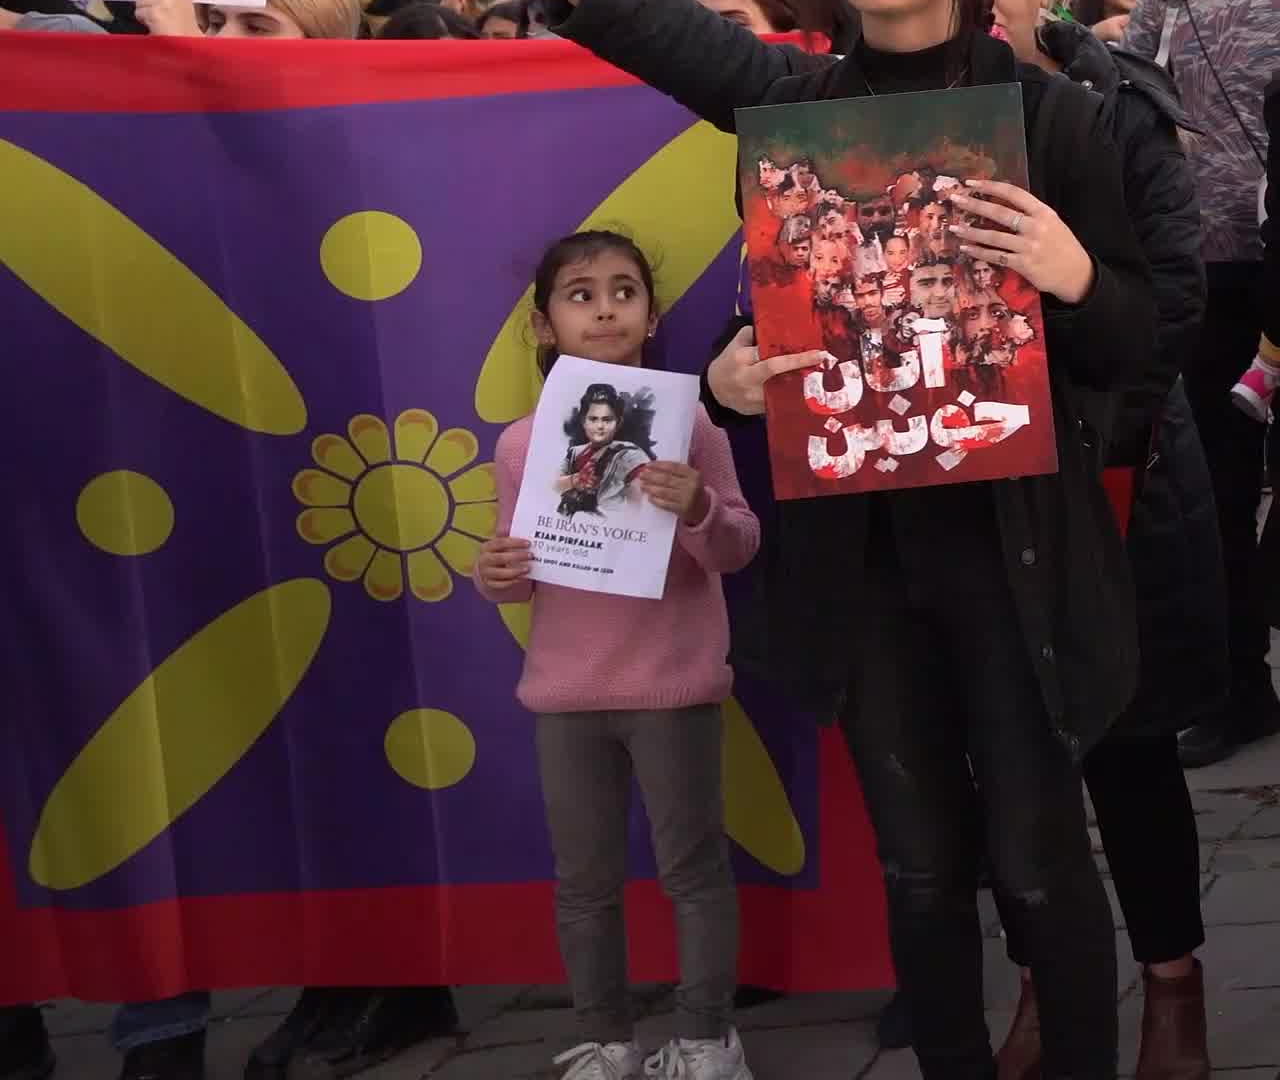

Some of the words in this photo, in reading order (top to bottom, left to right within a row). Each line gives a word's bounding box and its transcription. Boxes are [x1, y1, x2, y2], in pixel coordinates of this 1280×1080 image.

[533, 530, 558, 542] KIAN
[559, 535, 604, 550] PIRFALAK
[536, 515, 553, 528] BE
[554, 519, 601, 536] IRAN'S
[602, 526, 649, 543] VOICE
